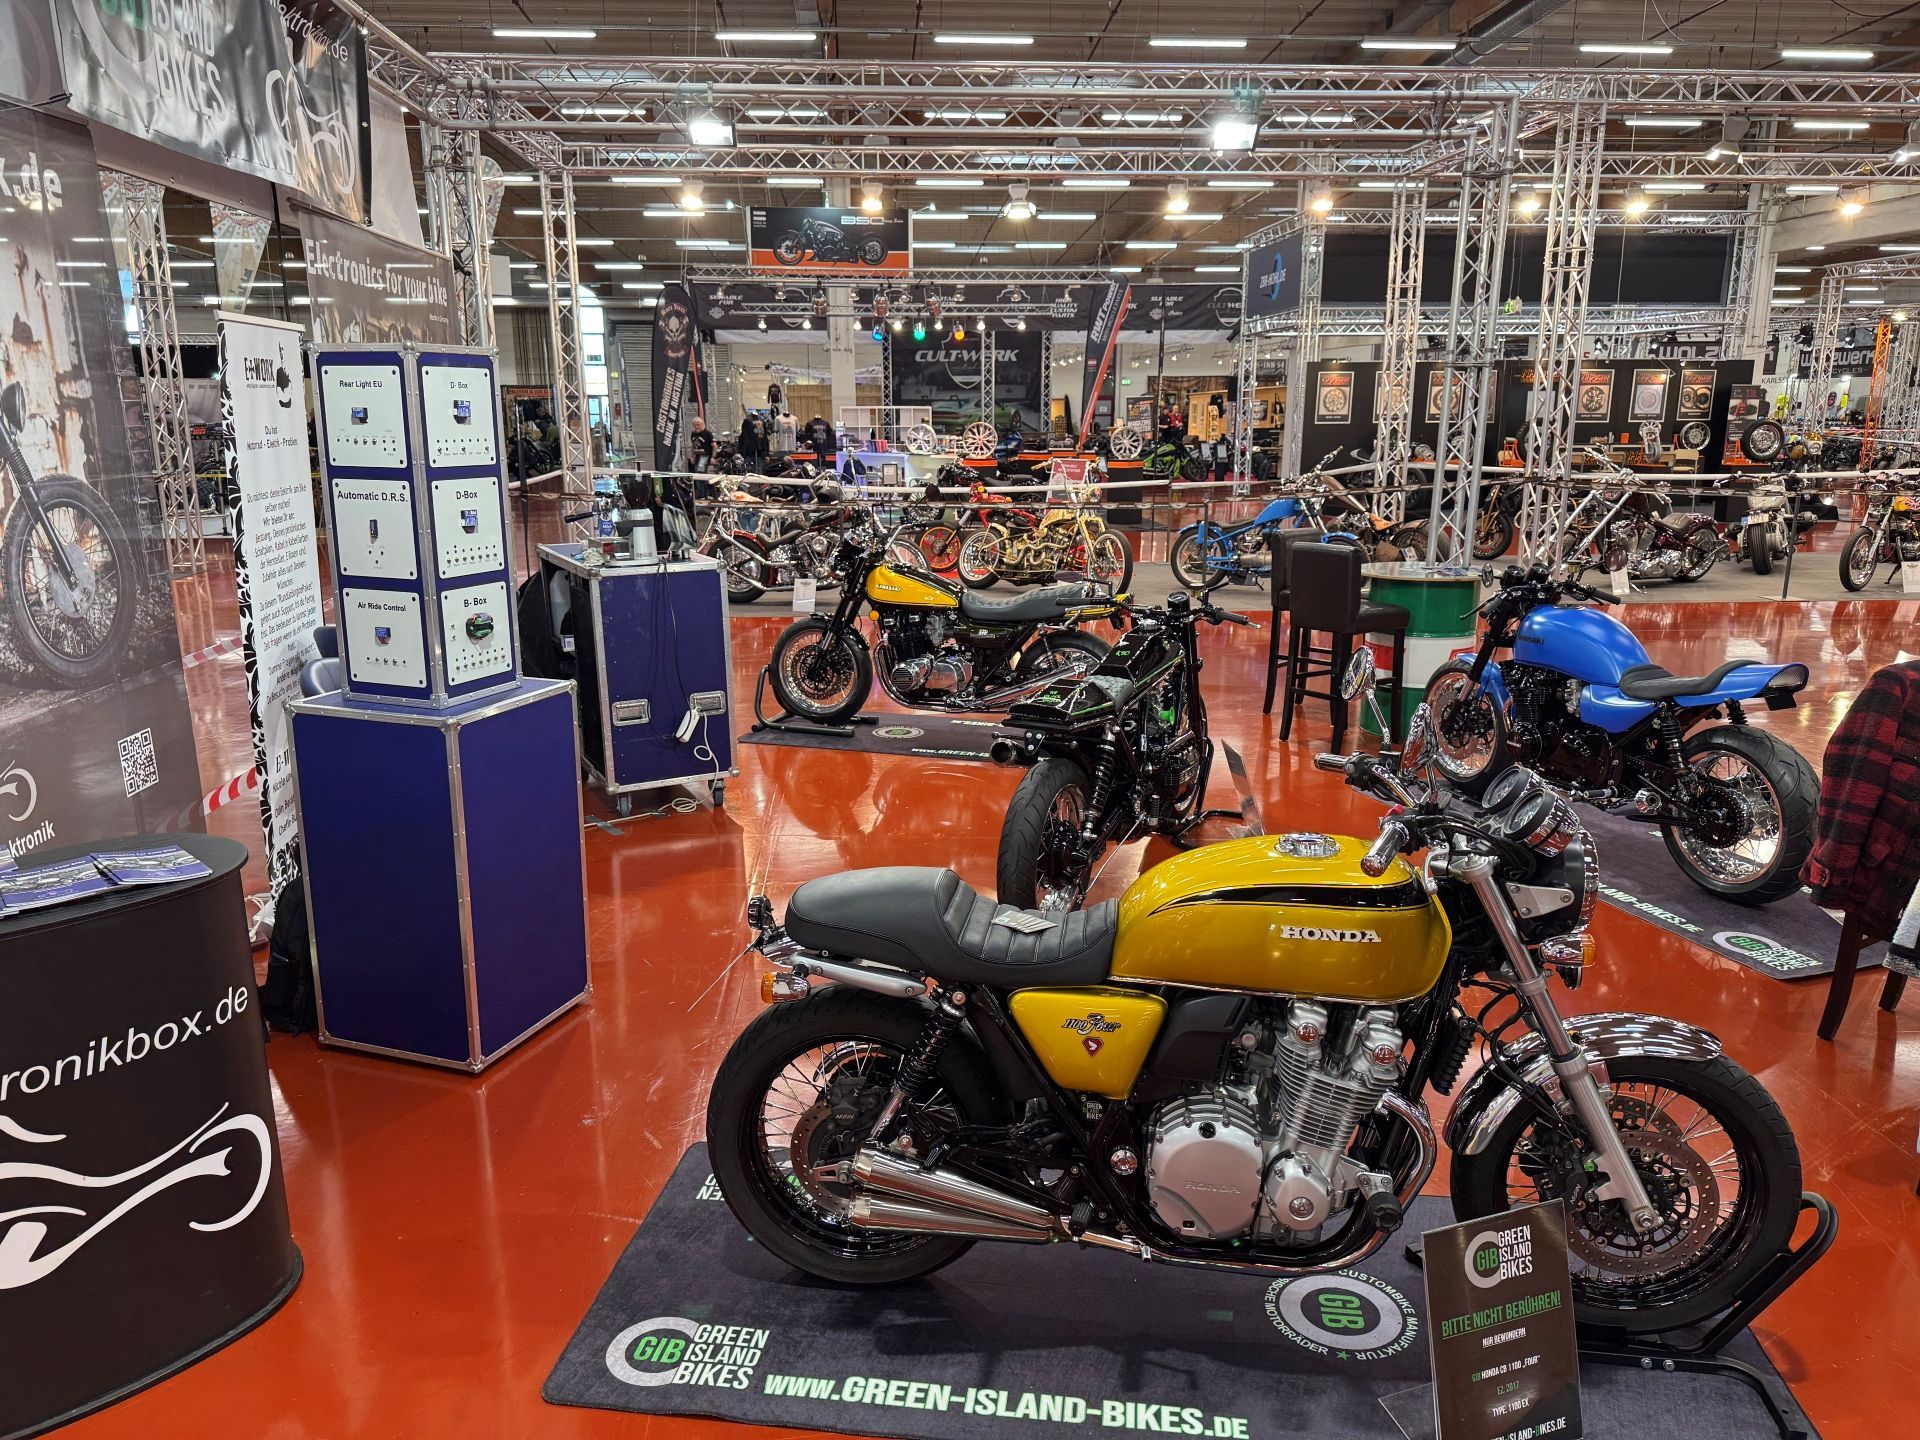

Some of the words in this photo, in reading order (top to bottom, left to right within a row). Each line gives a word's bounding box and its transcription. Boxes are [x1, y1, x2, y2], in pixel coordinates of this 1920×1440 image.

[154, 33, 227, 122] BIKES
[305, 238, 384, 291] Electronics
[385, 265, 403, 296] for
[403, 275, 427, 305] your
[428, 275, 448, 307] bike
[340, 380, 354, 388] Rear
[355, 380, 372, 389] Light
[372, 380, 383, 388] EU
[458, 381, 468, 389] Box
[656, 367, 676, 434] CUSTOMBIKES
[663, 422, 675, 447] MADE
[670, 371, 684, 410] AUSTRIA
[337, 490, 380, 501] Automatic
[381, 492, 408, 503] D.R.S.
[456, 490, 478, 500] D-Box
[368, 602, 382, 611] Ride
[382, 603, 407, 612] Control
[473, 597, 487, 606] Box
[1280, 925, 1382, 943] HONDA
[1061, 1019, 1089, 1031] 1100
[1184, 1181, 1241, 1195] HONDA
[1498, 1225, 1531, 1248] GREEN
[1476, 1248, 1499, 1271] GIB
[1499, 1241, 1532, 1263] ISLAND
[1500, 1256, 1533, 1280] BIKES
[1318, 1293, 1365, 1329] GIB
[1442, 1314, 1472, 1337] BITTE
[1473, 1305, 1504, 1329] NICHT
[1505, 1290, 1561, 1320] BERÜHREN!
[693, 1323, 770, 1349] GREEN
[1264, 1303, 1329, 1356] MOTORRÄDER
[1355, 1316, 1419, 1361] MANUFAKTUR
[632, 1336, 686, 1364] GIB
[682, 1343, 762, 1368] ISLAND
[671, 1362, 754, 1390] BIKES
[1481, 1367, 1500, 1380] HONDA
[1499, 1364, 1508, 1375] CB
[1508, 1360, 1521, 1372] 1100
[1492, 1405, 1508, 1418] TYPE:
[1521, 1397, 1530, 1408] EX
